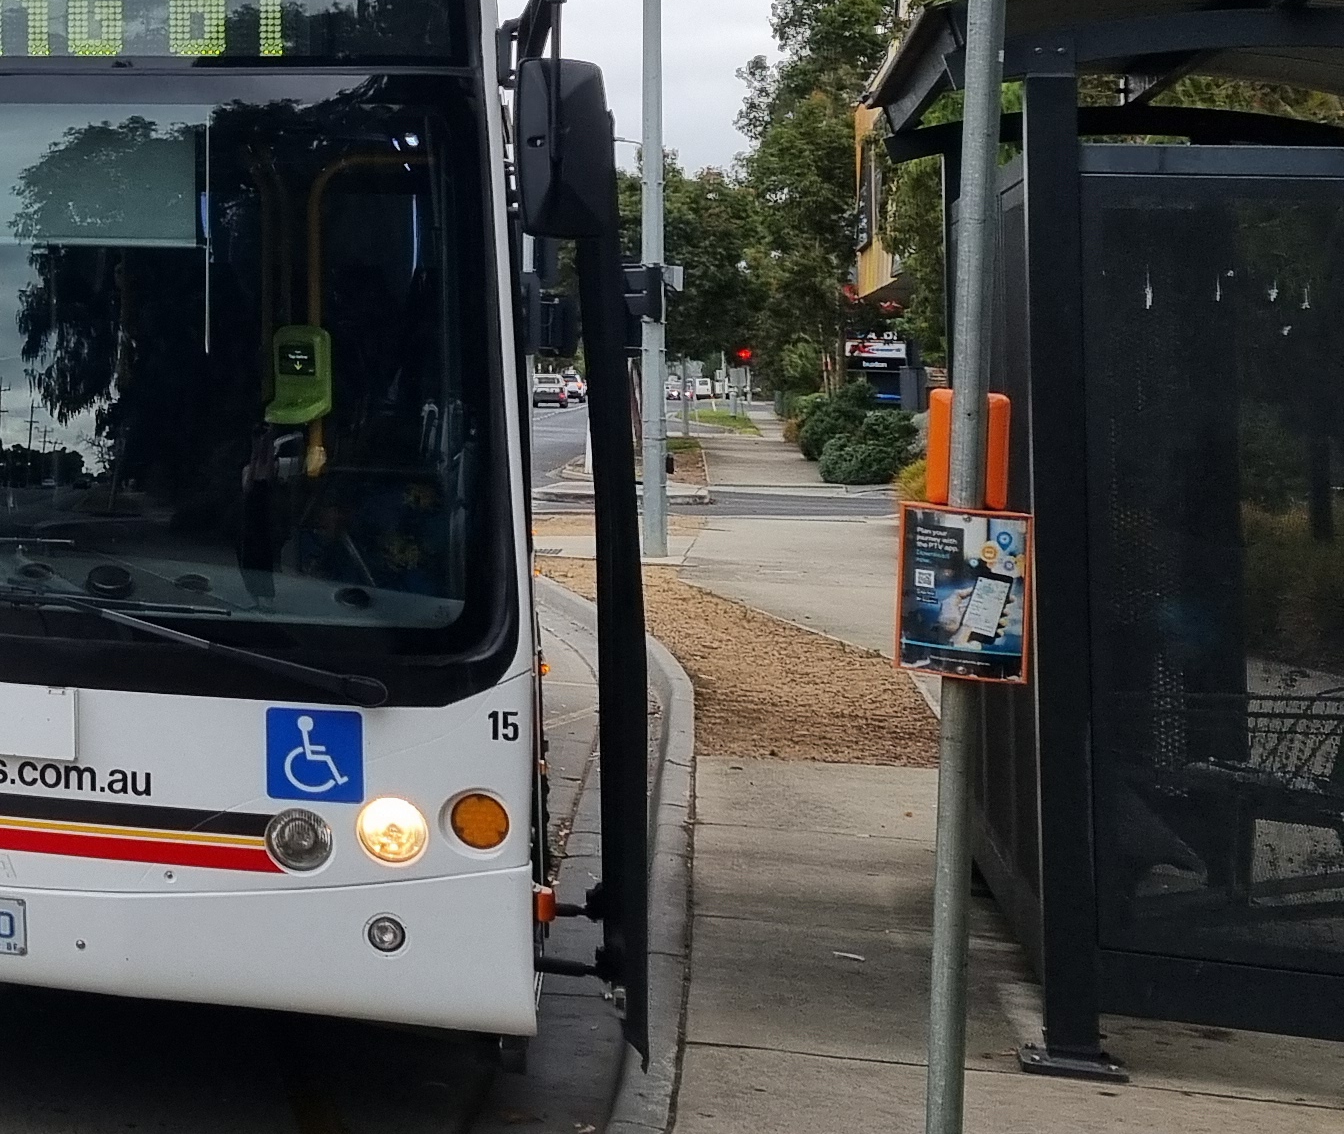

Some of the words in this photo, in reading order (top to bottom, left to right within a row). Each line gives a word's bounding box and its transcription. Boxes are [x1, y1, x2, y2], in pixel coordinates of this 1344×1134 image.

[916, 526, 932, 535] Plan
[916, 534, 941, 544] journey
[928, 542, 943, 550] PTV
[488, 710, 520, 742] 15
